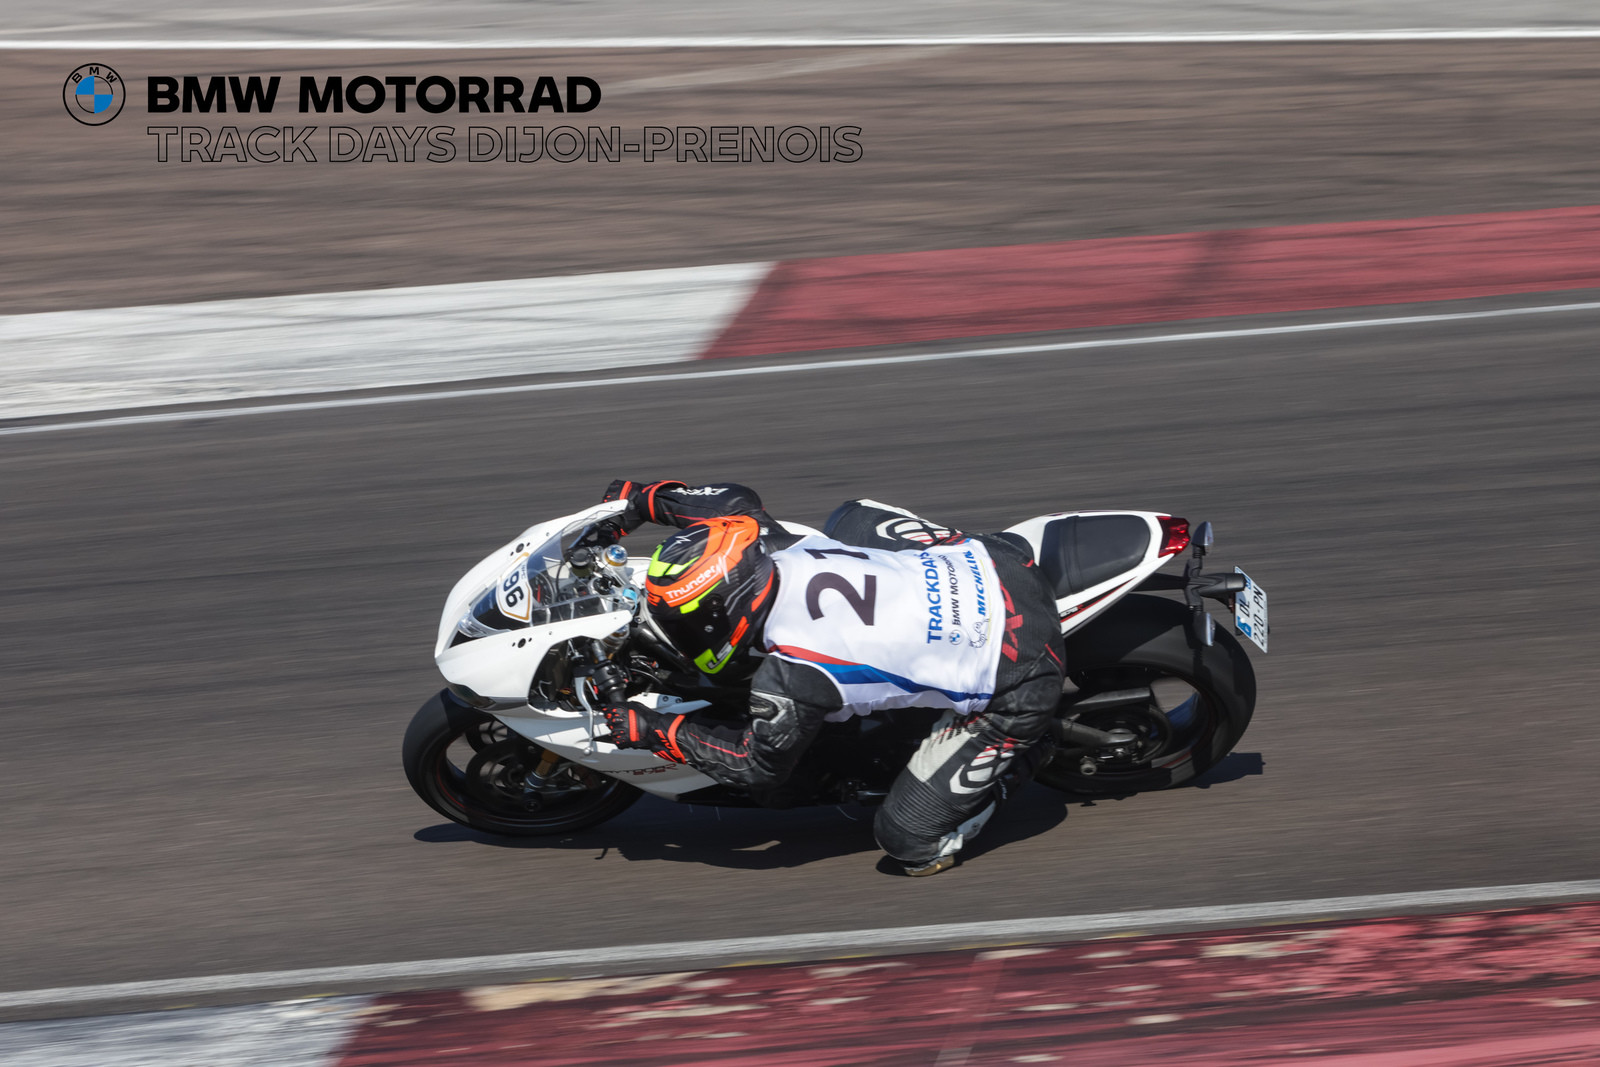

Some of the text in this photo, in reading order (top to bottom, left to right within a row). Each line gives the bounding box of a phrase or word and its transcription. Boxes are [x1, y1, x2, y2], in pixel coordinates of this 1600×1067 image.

[503, 570, 524, 608] 96
[665, 565, 716, 599] Thunder
[803, 548, 877, 626] 21
[963, 551, 986, 616] MICHELIN
[951, 598, 961, 627] BMW
